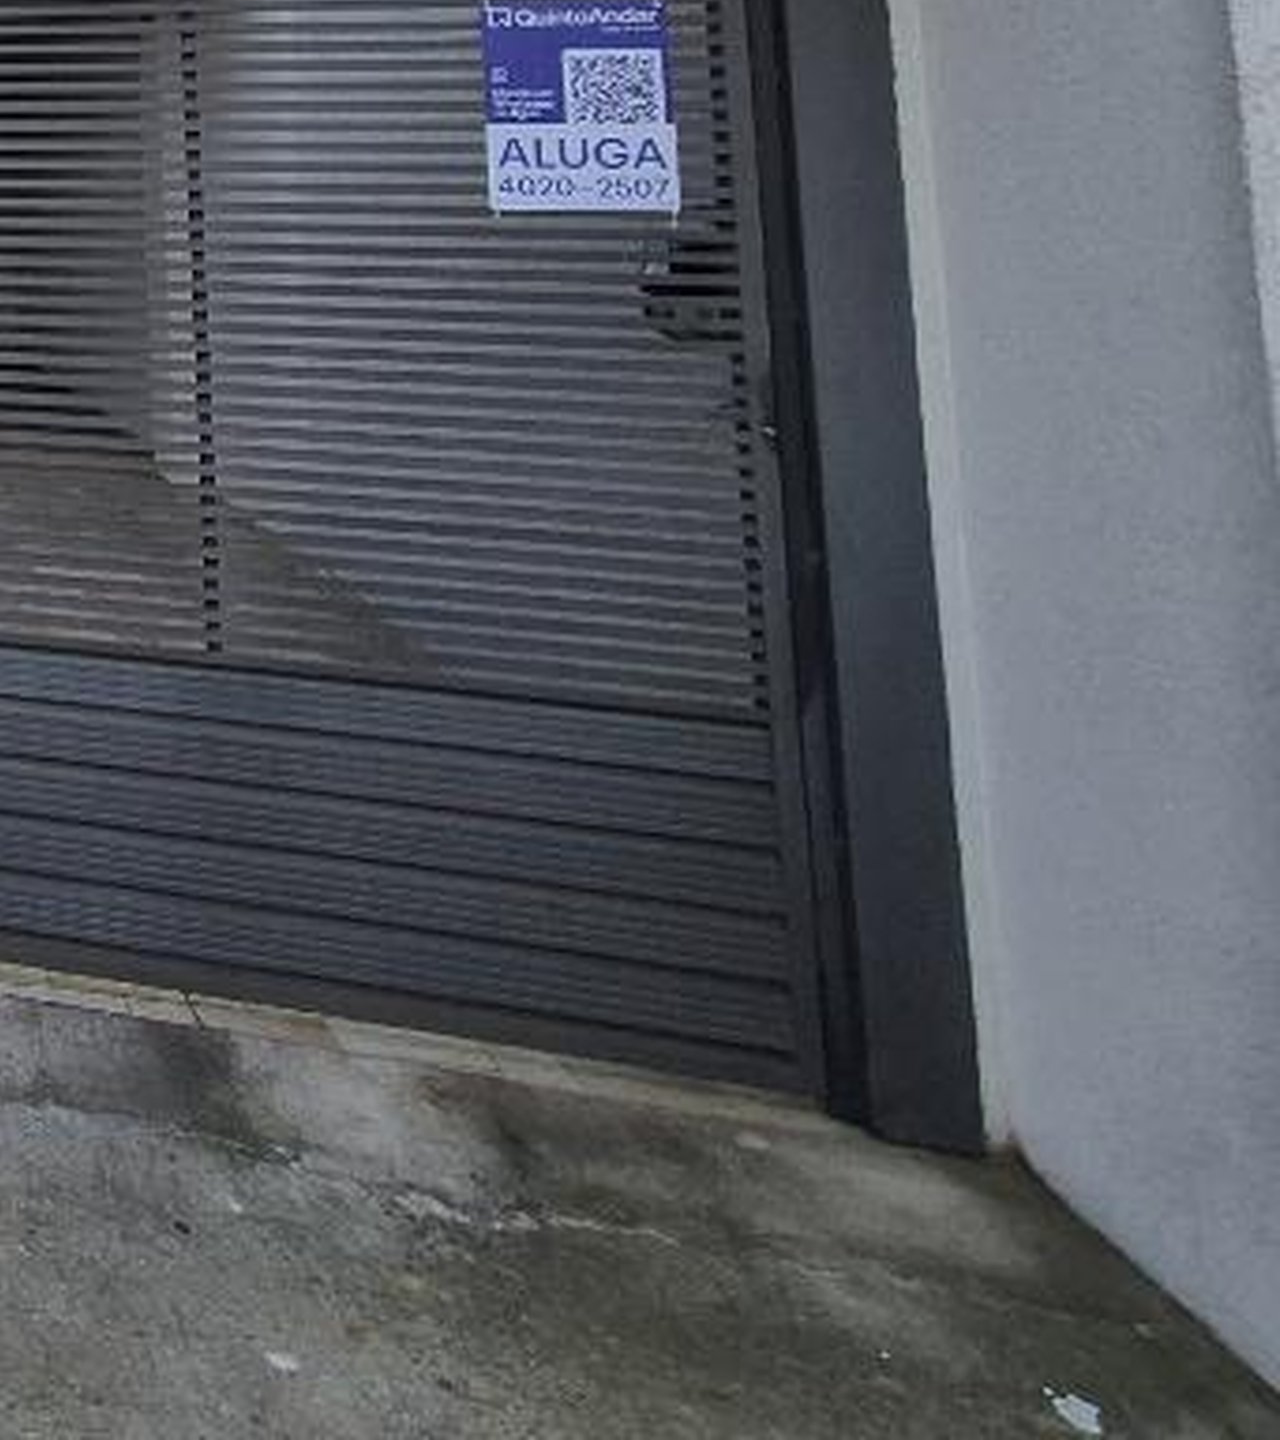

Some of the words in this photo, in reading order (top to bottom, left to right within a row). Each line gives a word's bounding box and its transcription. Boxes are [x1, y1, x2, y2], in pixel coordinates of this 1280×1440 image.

[514, 7, 658, 28] QuintoAndar
[499, 137, 667, 170] ALUGA
[499, 175, 670, 200] 4020-2507
